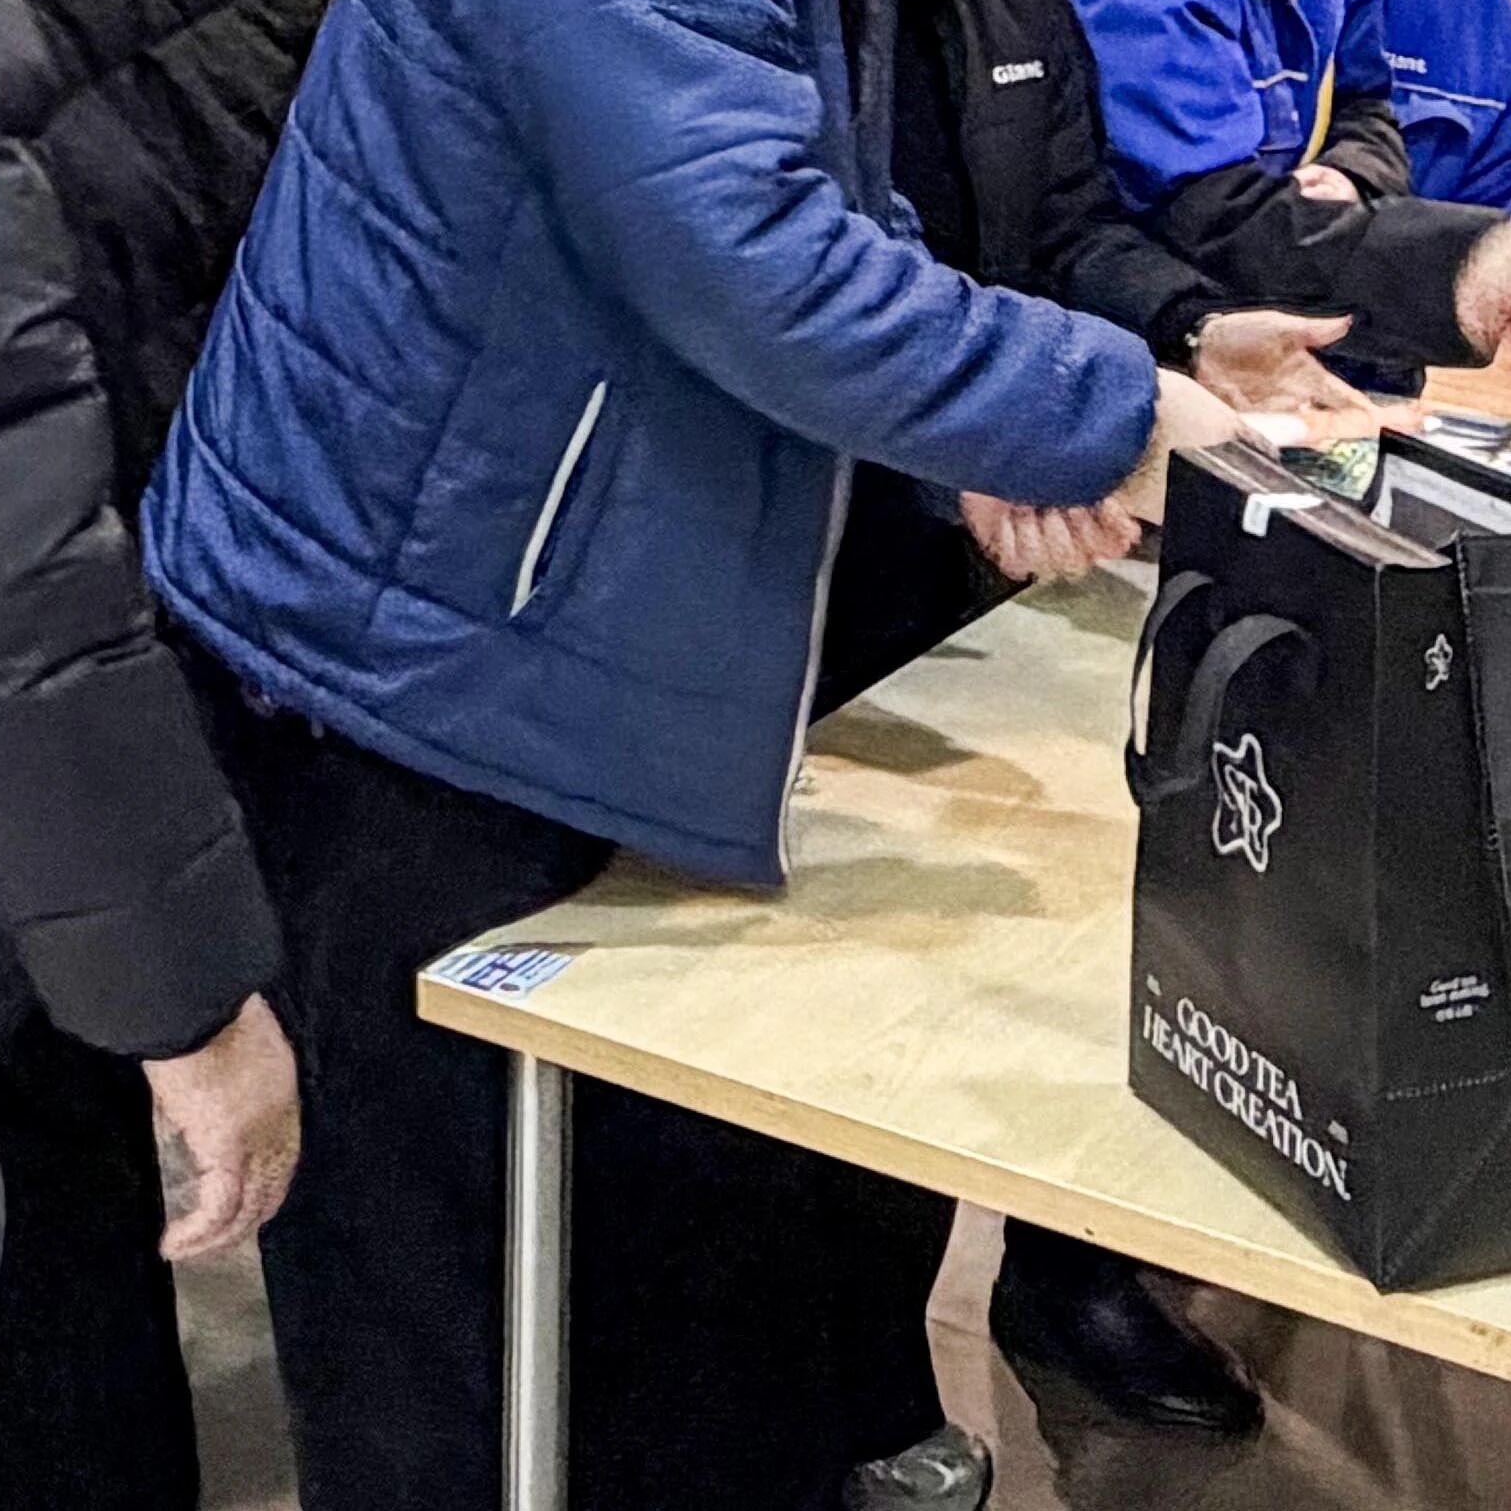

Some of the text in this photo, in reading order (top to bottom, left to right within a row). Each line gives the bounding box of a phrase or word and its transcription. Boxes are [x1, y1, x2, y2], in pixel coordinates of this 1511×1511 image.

[1142, 1004, 1352, 1201] HEART CREATION
[1176, 996, 1304, 1121] GOOD TEA
